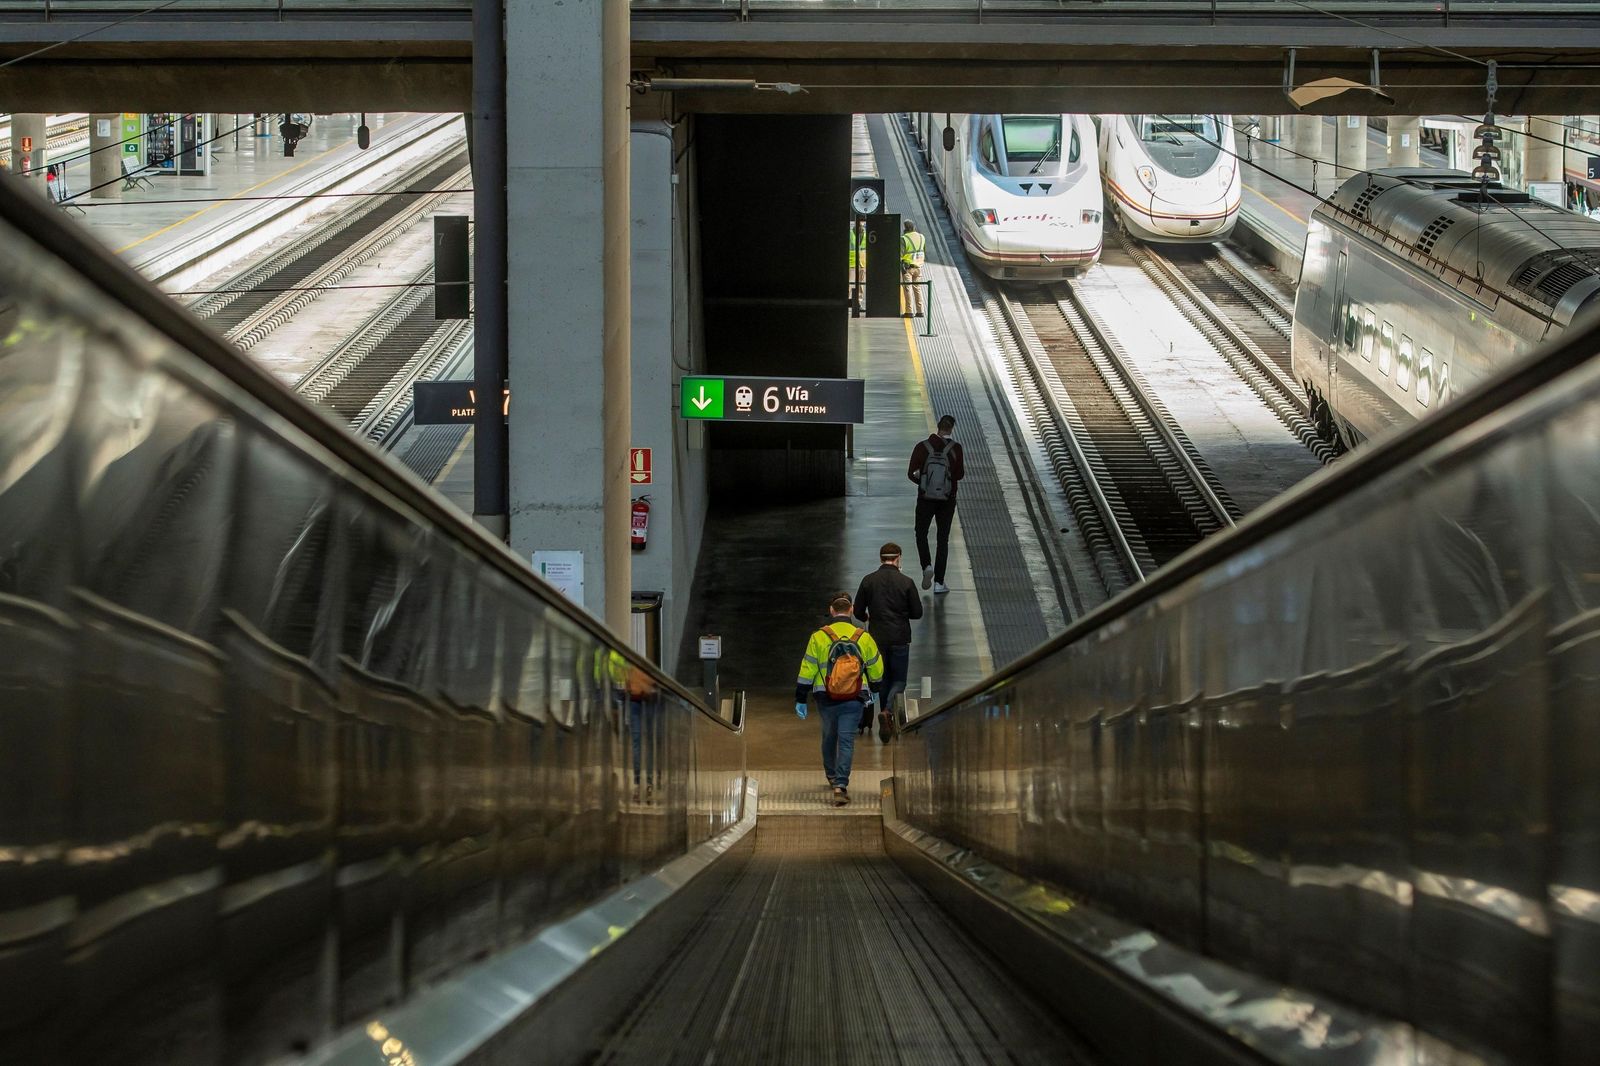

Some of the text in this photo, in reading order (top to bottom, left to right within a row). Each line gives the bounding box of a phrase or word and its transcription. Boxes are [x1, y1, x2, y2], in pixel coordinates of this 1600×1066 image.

[1588, 167, 1595, 178] 5
[437, 232, 445, 246] 7
[868, 230, 878, 244] 6
[763, 386, 809, 413] 6 Vía
[451, 408, 476, 417] PLATF
[785, 405, 826, 414] PLATFORM
